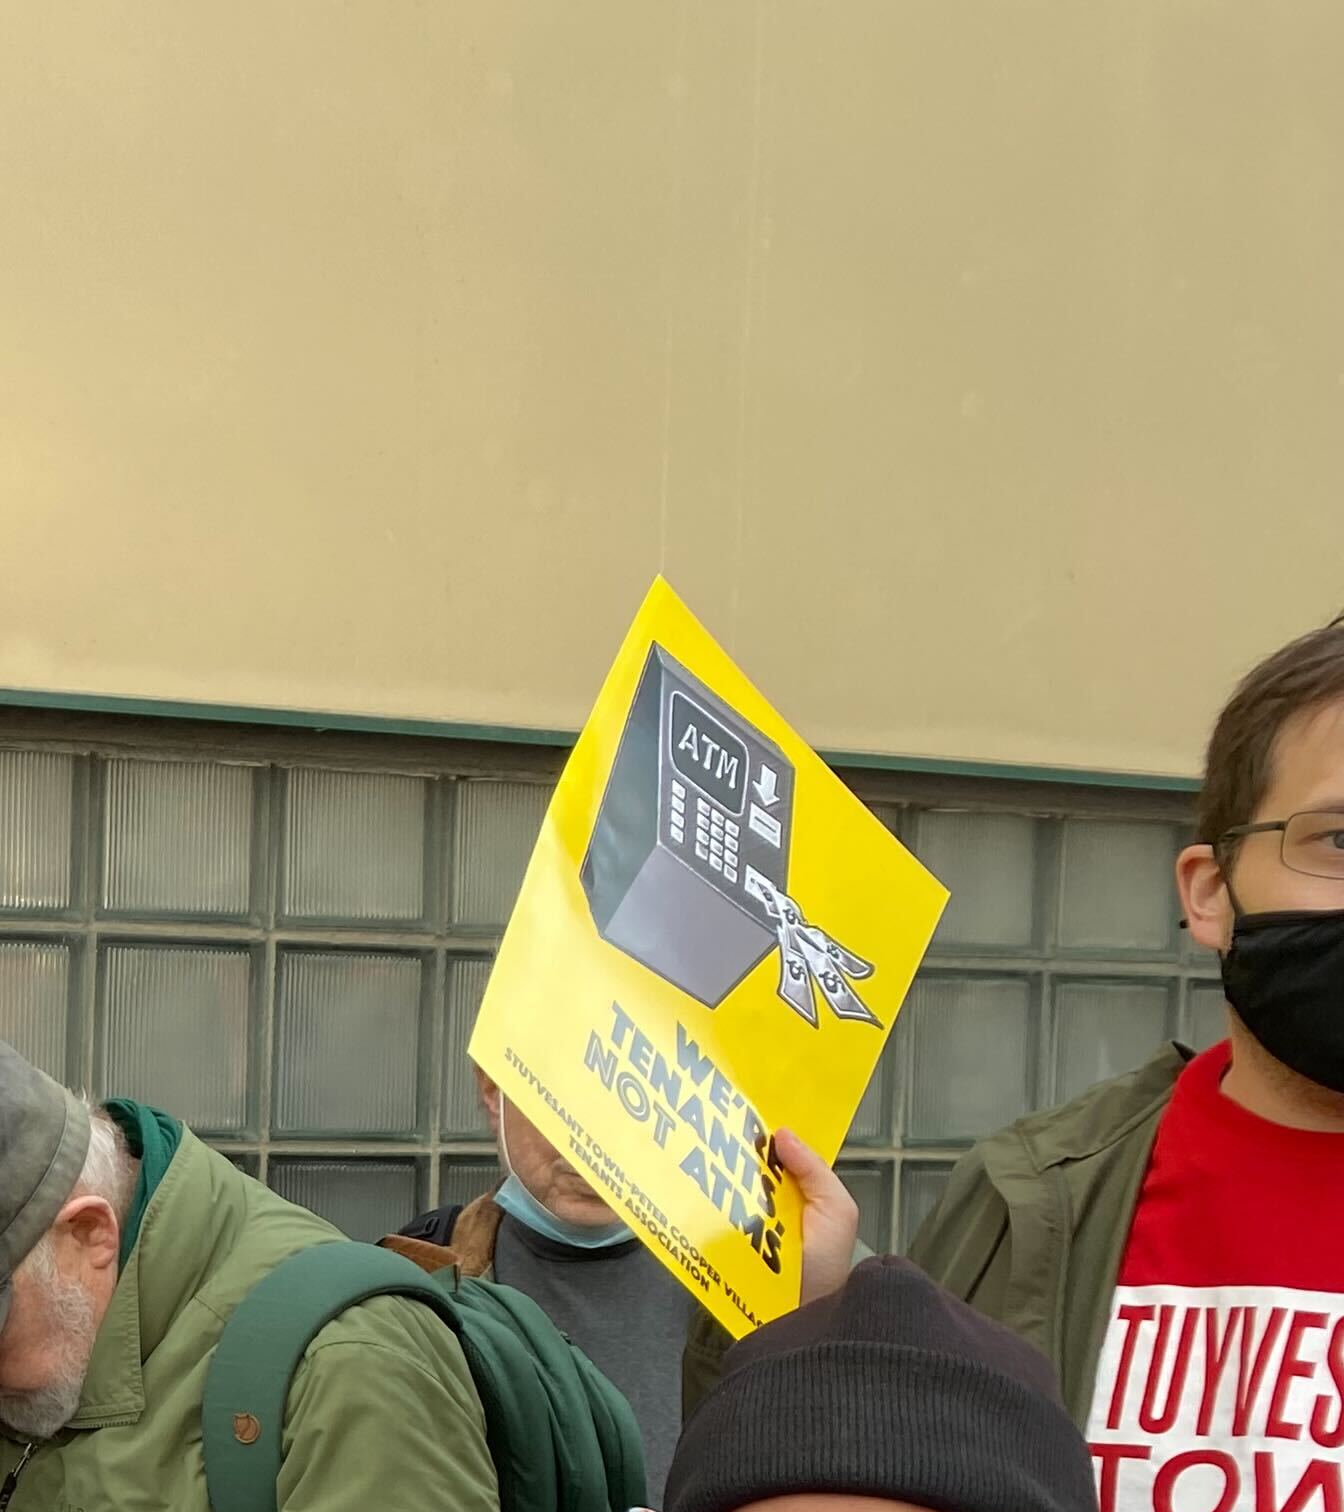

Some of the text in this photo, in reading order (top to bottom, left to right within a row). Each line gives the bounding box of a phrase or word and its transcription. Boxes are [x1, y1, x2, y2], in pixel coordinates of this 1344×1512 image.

[678, 723, 739, 789] ATM
[505, 1047, 584, 1138] STUYVESANT
[670, 1224, 722, 1287] COOPER
[568, 1134, 710, 1292] TENANTS ASSOCIATION
[584, 1029, 782, 1275] NOT ATMS
